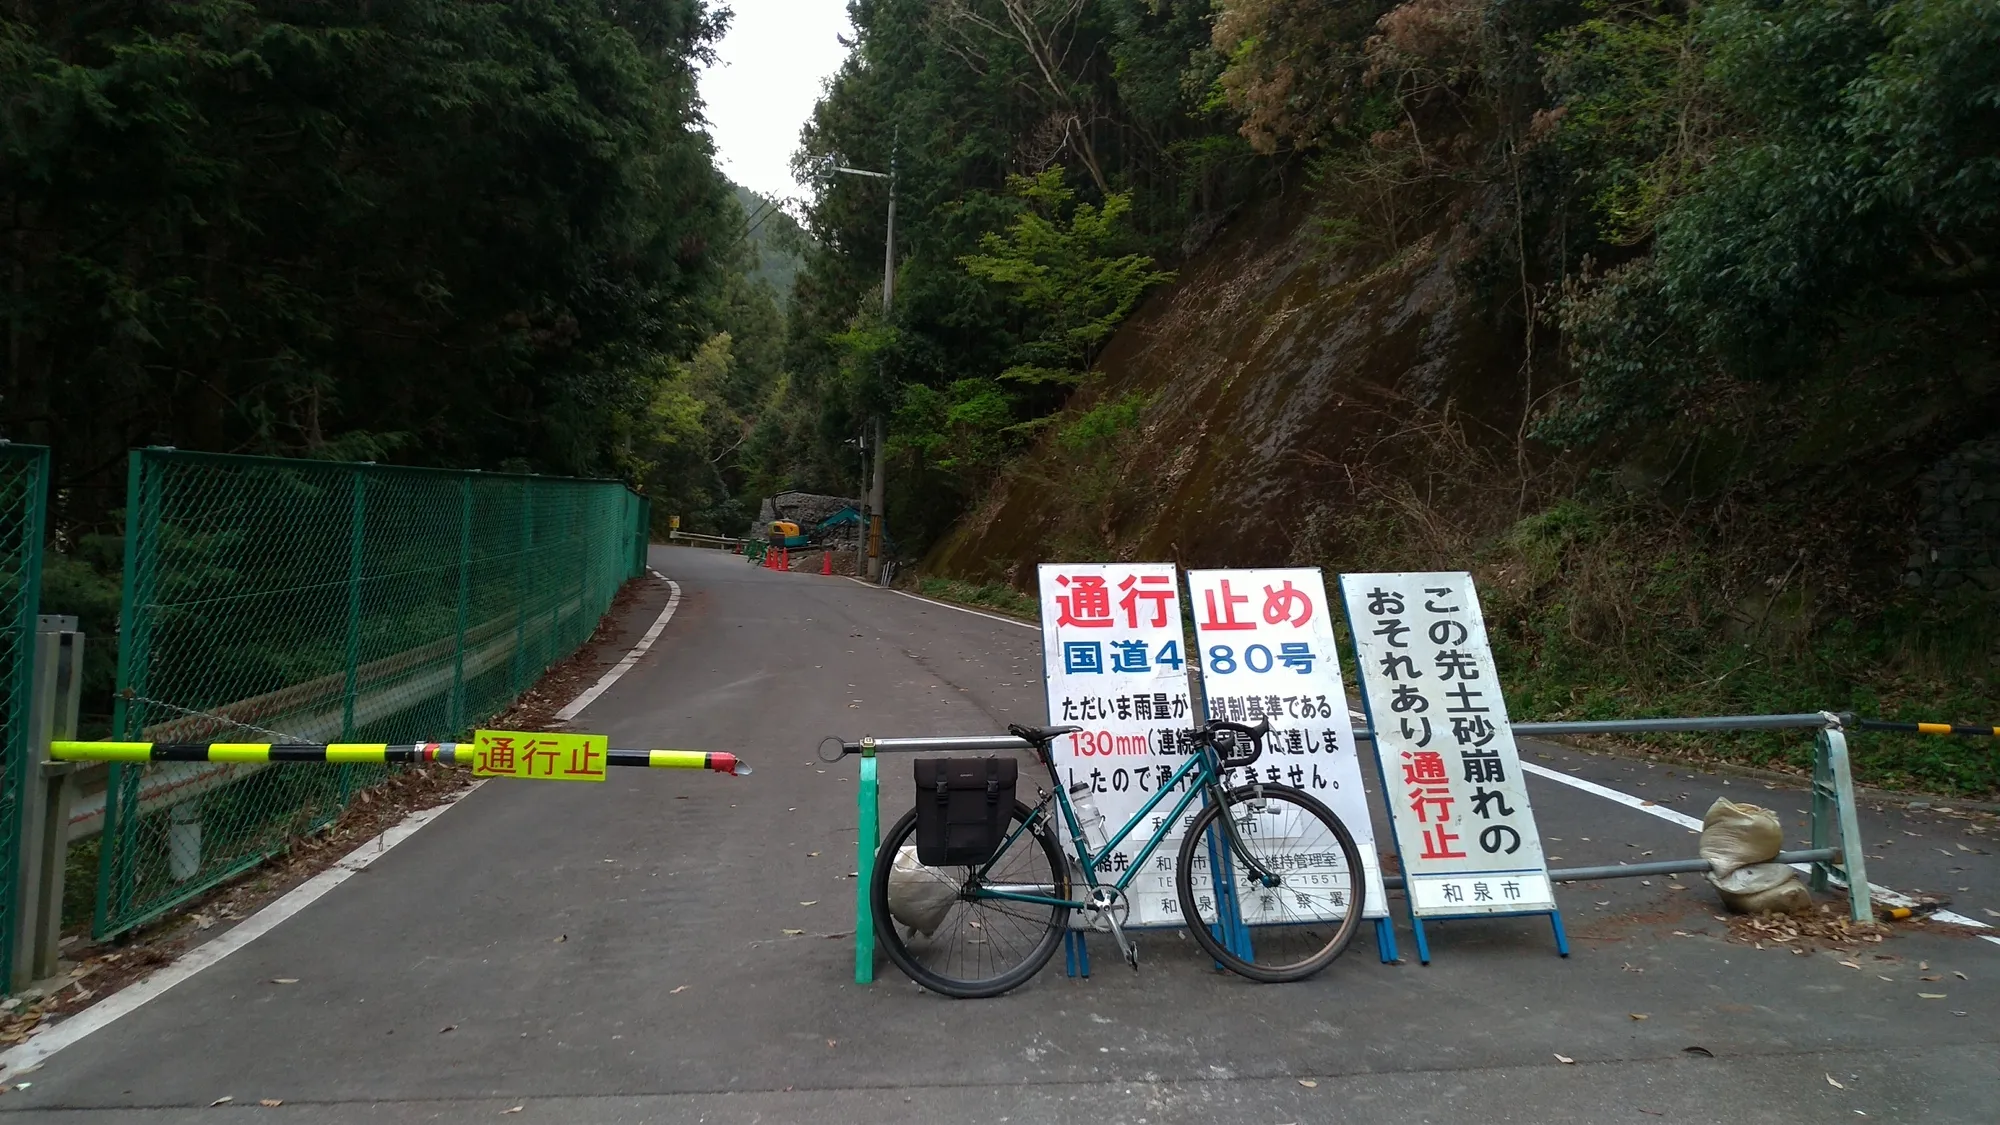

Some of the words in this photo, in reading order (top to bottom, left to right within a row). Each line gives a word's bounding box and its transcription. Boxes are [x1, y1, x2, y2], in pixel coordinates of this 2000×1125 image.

[1055, 574, 1175, 629] 通行
[1200, 579, 1313, 631] 止め
[1063, 640, 1183, 674] 国道4
[1209, 642, 1317, 675] 80号
[1062, 693, 1189, 721] ただいま雨量が
[1210, 694, 1332, 720] 規制基準である
[1424, 587, 1521, 855] この先土砂崩れの
[477, 737, 604, 776] 通行止
[1087, 852, 1129, 872] 絡先
[1156, 854, 1206, 871] 和市
[1442, 881, 1521, 902] 和泉市
